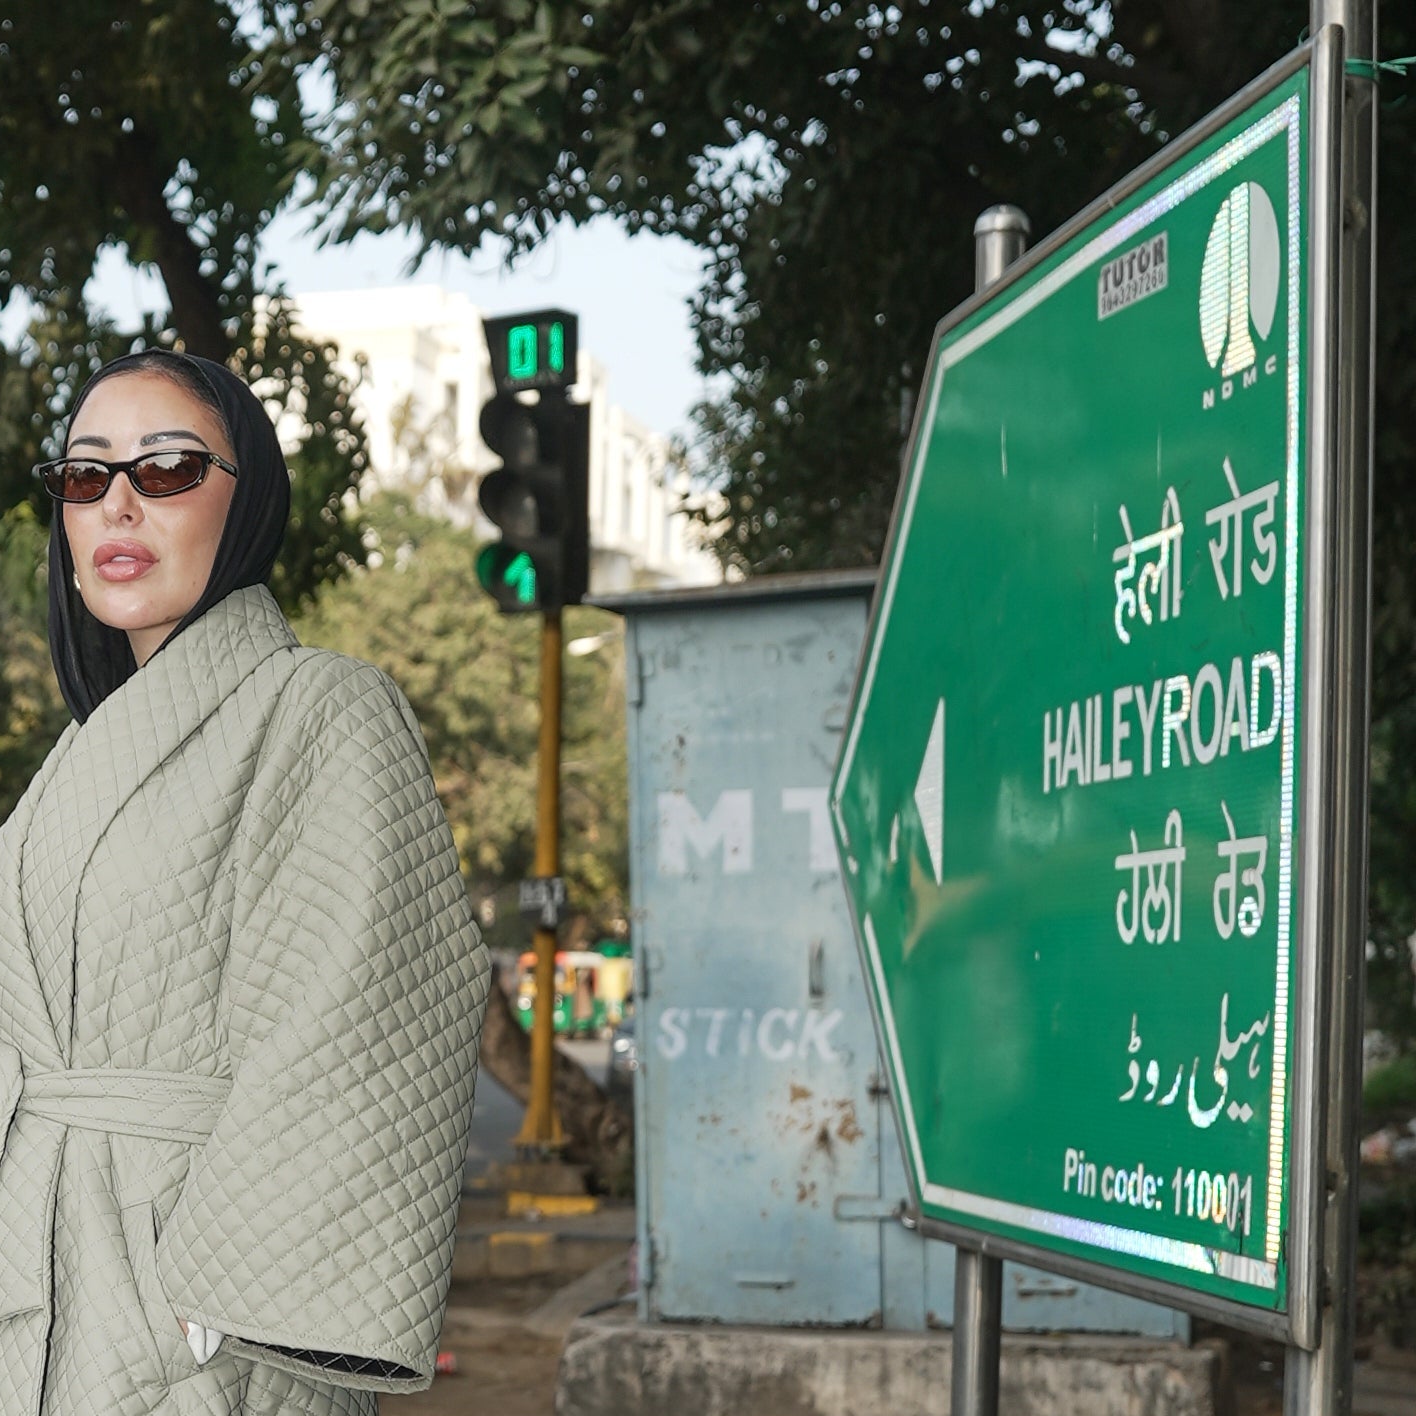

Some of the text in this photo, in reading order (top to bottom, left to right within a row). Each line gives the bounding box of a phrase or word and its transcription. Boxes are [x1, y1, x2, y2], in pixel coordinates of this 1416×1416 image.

[1101, 237, 1165, 294] TUTOR
[508, 321, 564, 379] 01
[1202, 354, 1277, 411] NDMC
[1112, 455, 1280, 645] हेली रोड
[1114, 807, 1187, 945] ਹੇਲੀ
[656, 1005, 844, 1063] STICK
[1063, 1147, 1253, 1237] Pin code: 110001
